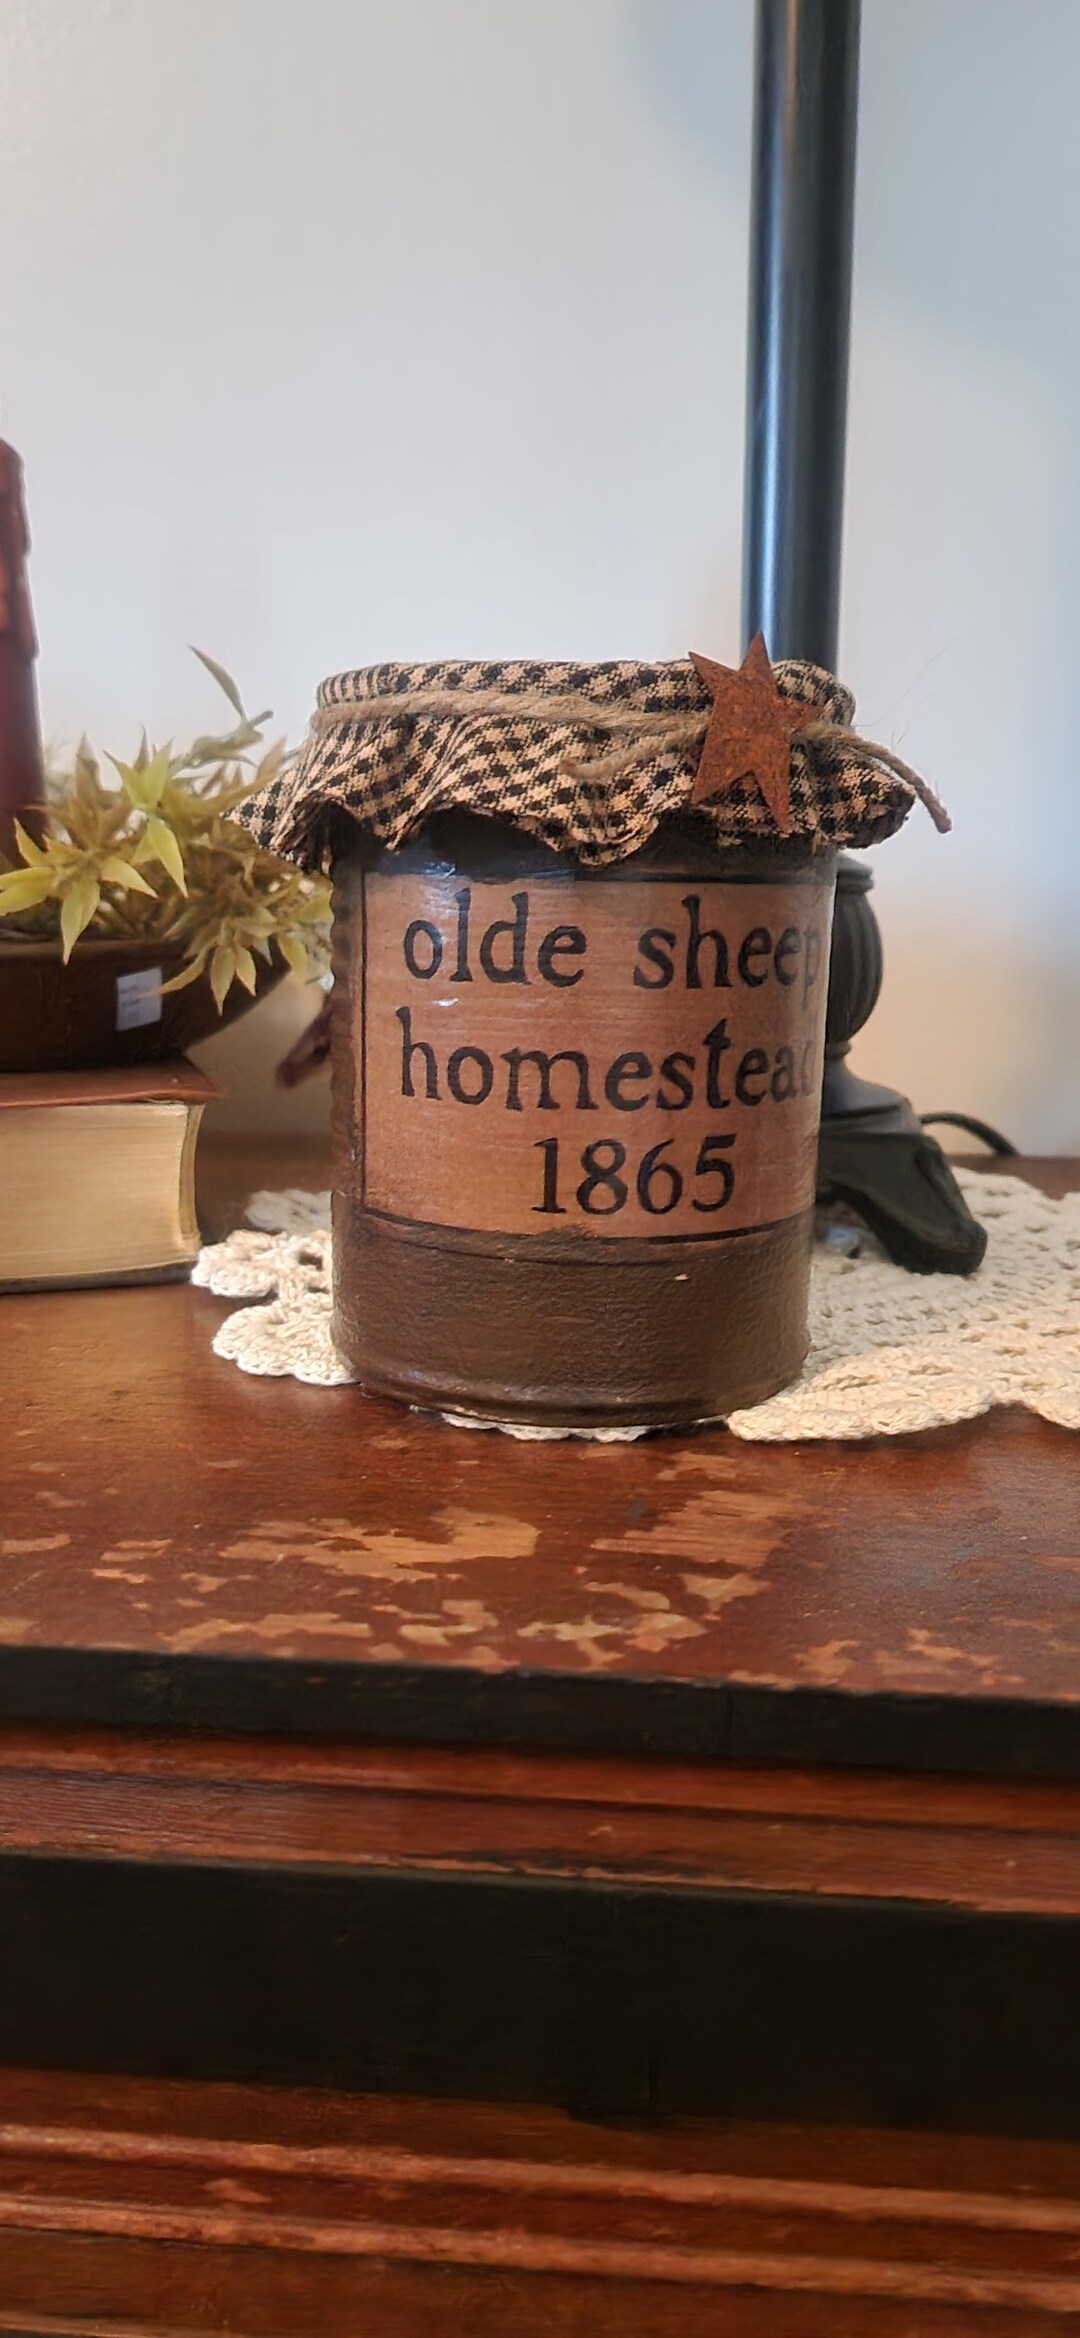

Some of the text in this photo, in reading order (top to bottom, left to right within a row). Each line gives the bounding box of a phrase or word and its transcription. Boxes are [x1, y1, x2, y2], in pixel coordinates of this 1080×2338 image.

[403, 888, 821, 1012] olde sheep
[531, 1134, 737, 1215] 1865
